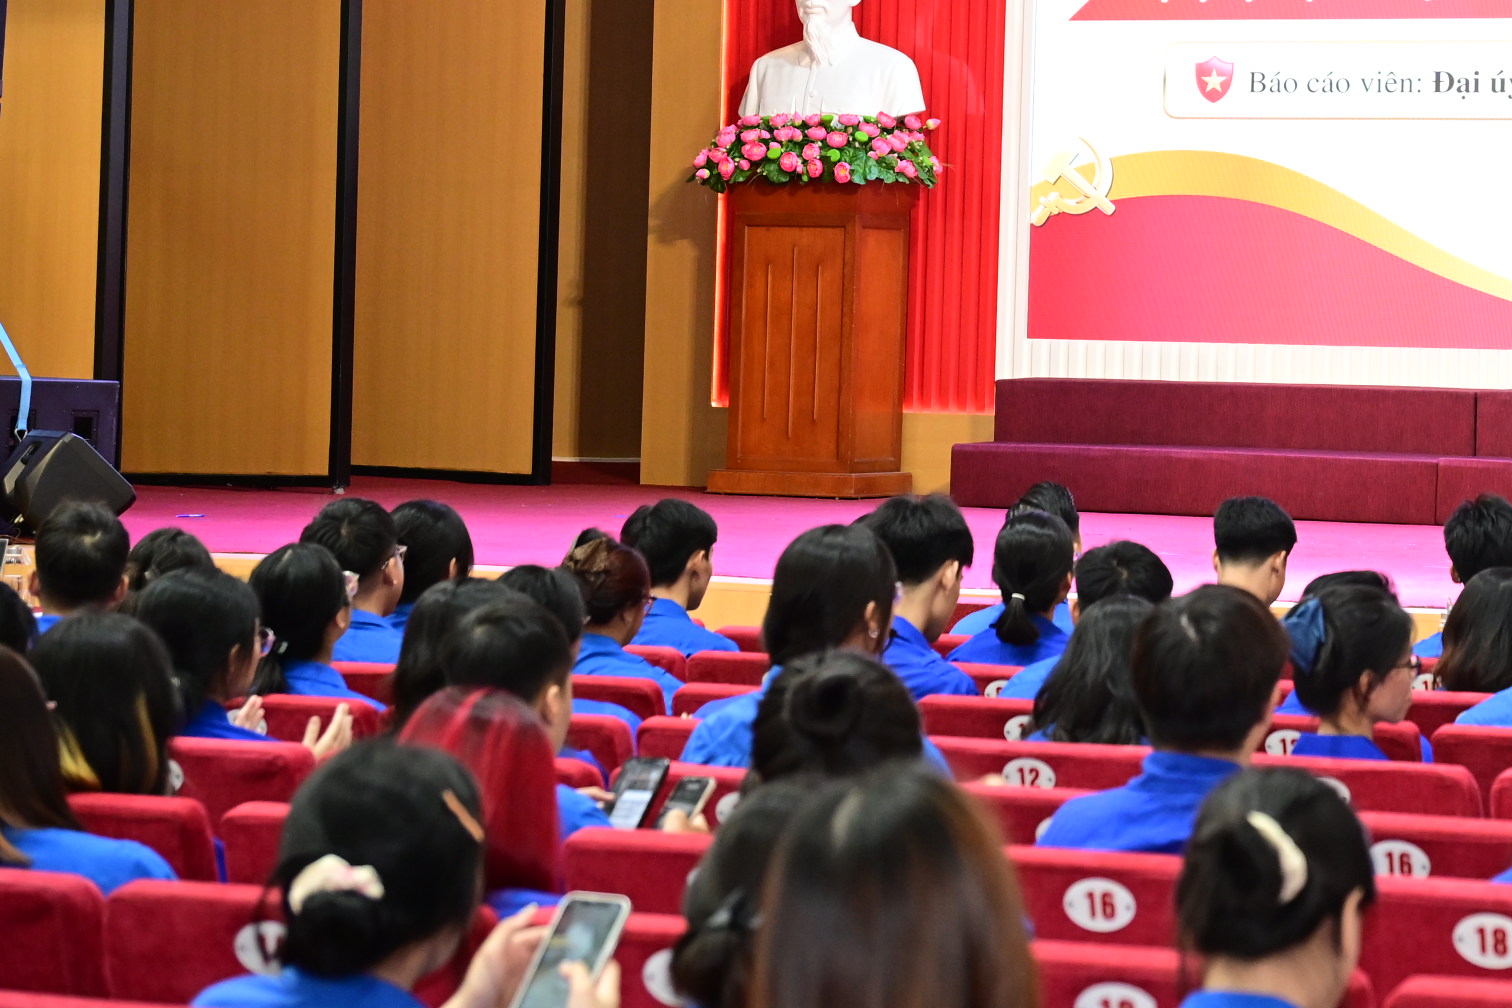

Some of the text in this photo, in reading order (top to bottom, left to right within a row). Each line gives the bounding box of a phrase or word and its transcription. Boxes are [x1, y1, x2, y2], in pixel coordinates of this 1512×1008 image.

[1249, 71, 1299, 94] Báo
[1306, 71, 1351, 94] cáo
[1360, 71, 1422, 94] viên:
[1431, 70, 1480, 100] Đại
[1016, 767, 1041, 788] 12
[1385, 851, 1412, 876] 16
[1085, 890, 1115, 921] 16
[1477, 926, 1507, 957] 18
